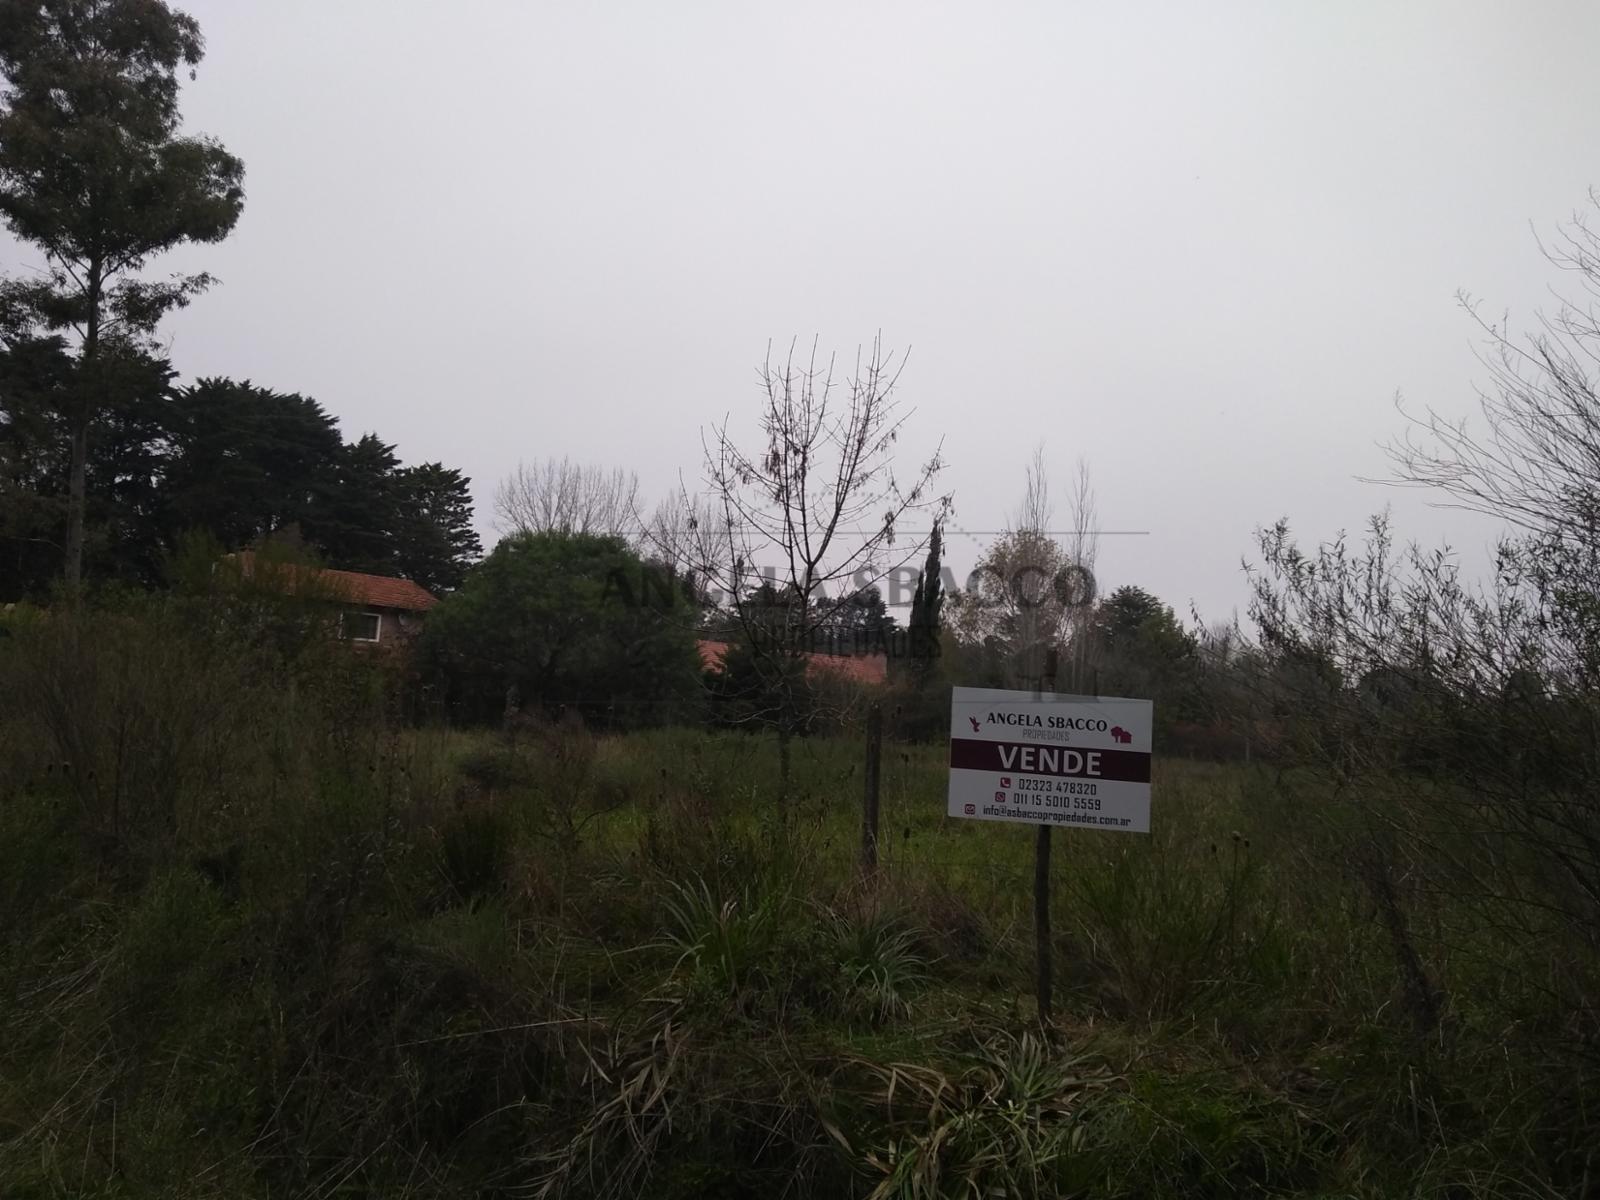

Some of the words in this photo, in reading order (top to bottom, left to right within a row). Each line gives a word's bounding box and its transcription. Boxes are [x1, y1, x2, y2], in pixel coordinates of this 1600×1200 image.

[986, 712, 1043, 728] ANGELA
[1047, 716, 1108, 732] SBACCO
[1022, 729, 1070, 742] PROPIEDADES
[998, 745, 1102, 776] VENDE
[1018, 778, 1052, 792] 02323
[1056, 781, 1097, 796] 478320
[1013, 792, 1028, 805] 011
[1032, 793, 1042, 806] 15
[1045, 795, 1070, 807] 5010
[1074, 797, 1101, 811] 5559
[983, 805, 1131, 827] info@asbaccopropiedades.com.ar
